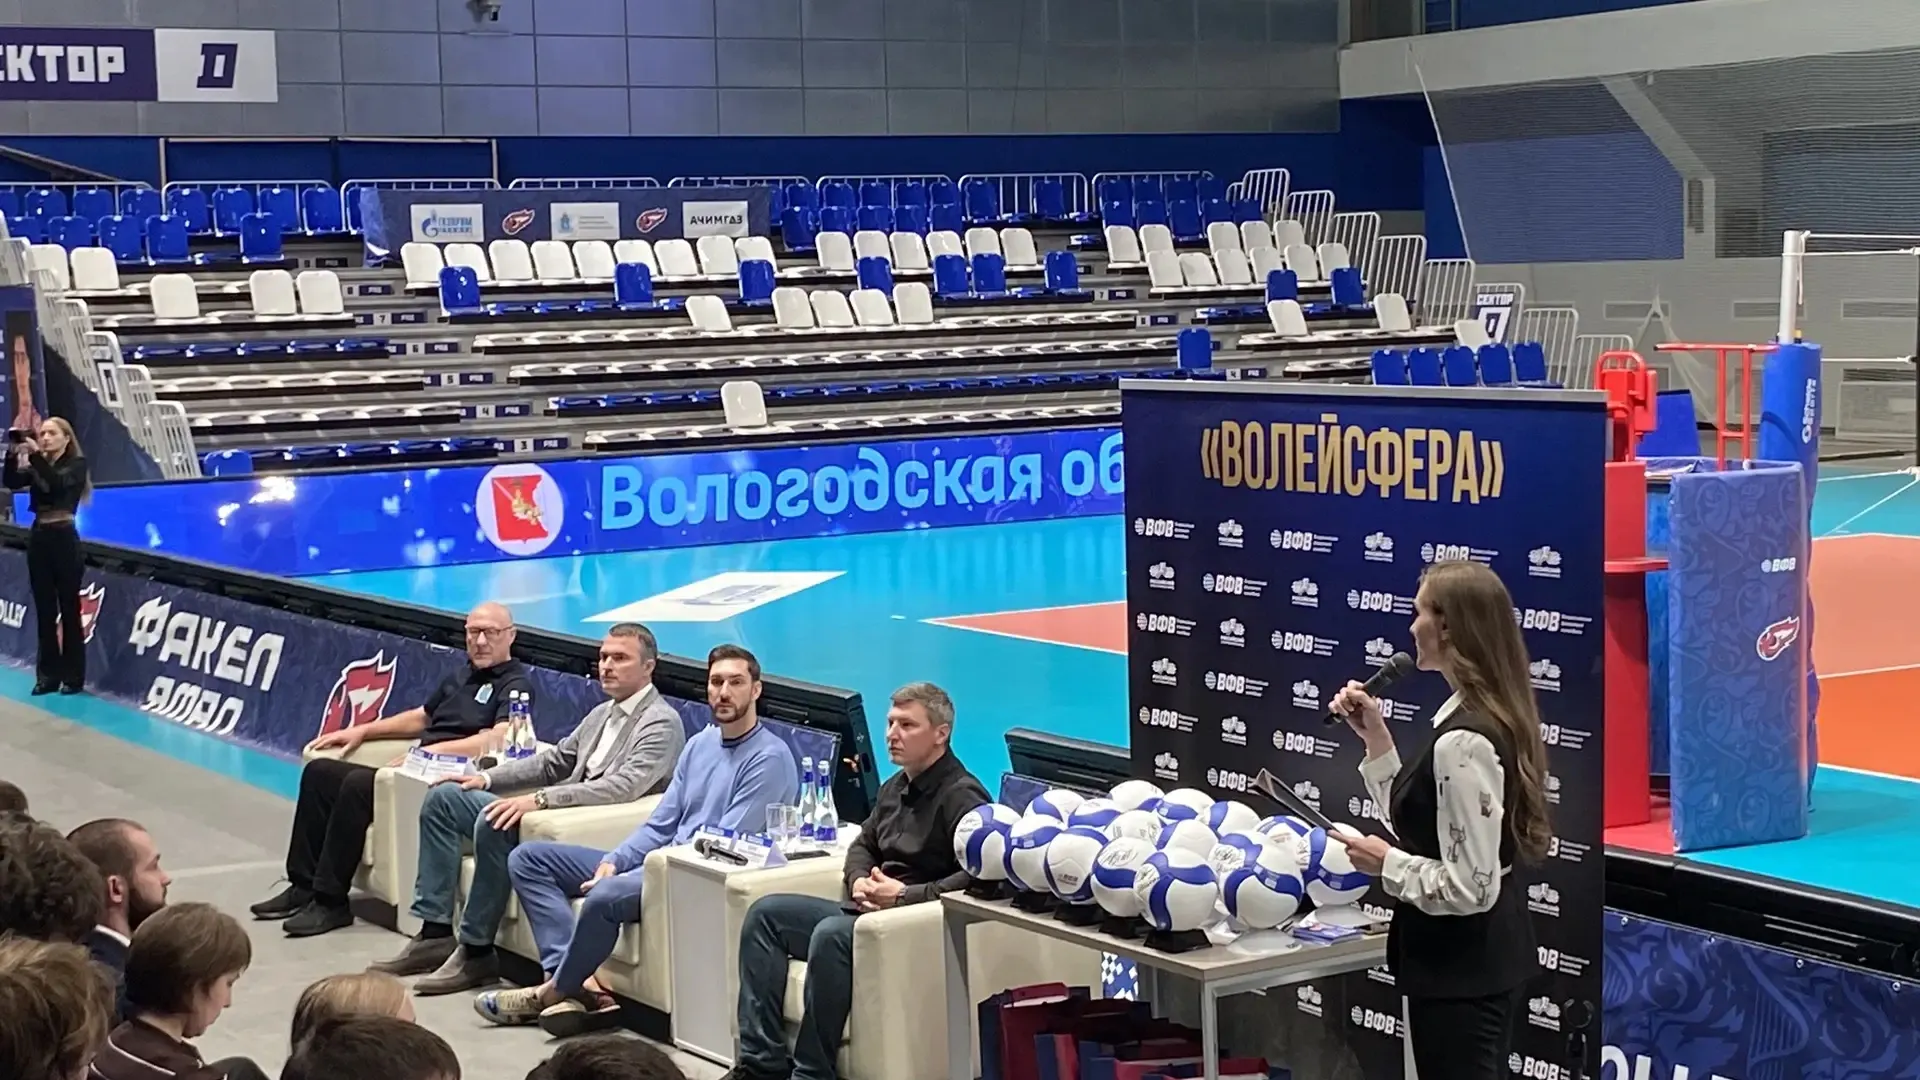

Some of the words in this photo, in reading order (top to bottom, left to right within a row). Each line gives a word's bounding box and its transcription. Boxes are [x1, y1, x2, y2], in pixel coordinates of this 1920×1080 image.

[0, 45, 125, 82] КТОР
[1201, 413, 1504, 504] «ВОЛЕЙСФЕРА»
[601, 447, 1042, 529] Вологодская
[1145, 518, 1174, 537] ВФВ
[1282, 530, 1313, 551] ВФВ
[1215, 574, 1244, 595] ВФВ
[1360, 590, 1393, 613] ВФВ
[1147, 613, 1176, 634] ВФВ
[1523, 608, 1561, 632] ВФВ
[128, 596, 285, 691] ФАКЕЛ
[1283, 631, 1314, 654] ВФВ
[1217, 672, 1245, 694] ВФВ
[1150, 708, 1178, 729] ВФВ
[1284, 732, 1315, 754] ВФВ
[1218, 769, 1247, 792] ВФВ
[1537, 946, 1559, 970] ФВ
[1363, 1008, 1395, 1034] ВФВ
